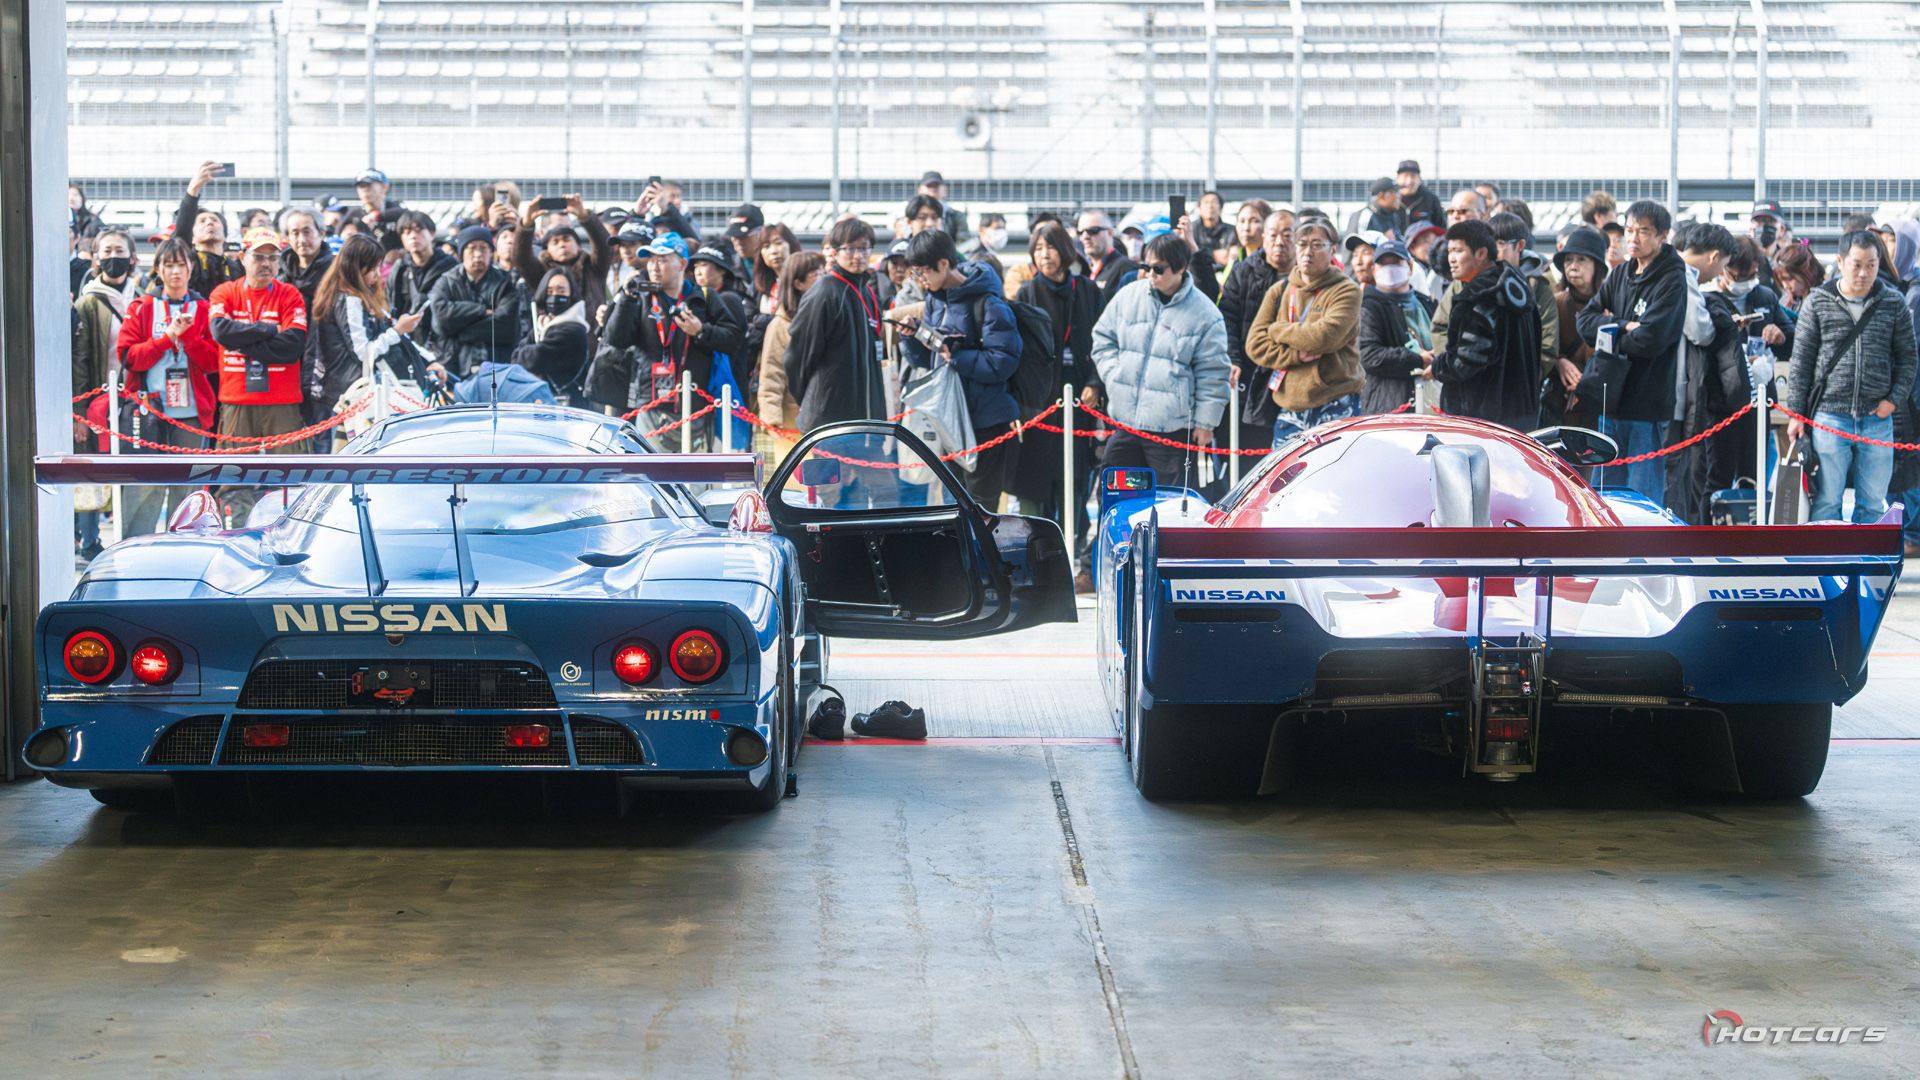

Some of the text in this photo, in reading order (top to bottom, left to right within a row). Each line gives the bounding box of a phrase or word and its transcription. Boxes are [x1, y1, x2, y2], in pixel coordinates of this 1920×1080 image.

[188, 464, 624, 483] BRIDGESTONE
[1176, 589, 1286, 600] NISSAN
[1708, 588, 1820, 600] NISSAN
[272, 604, 508, 632] NISSAN
